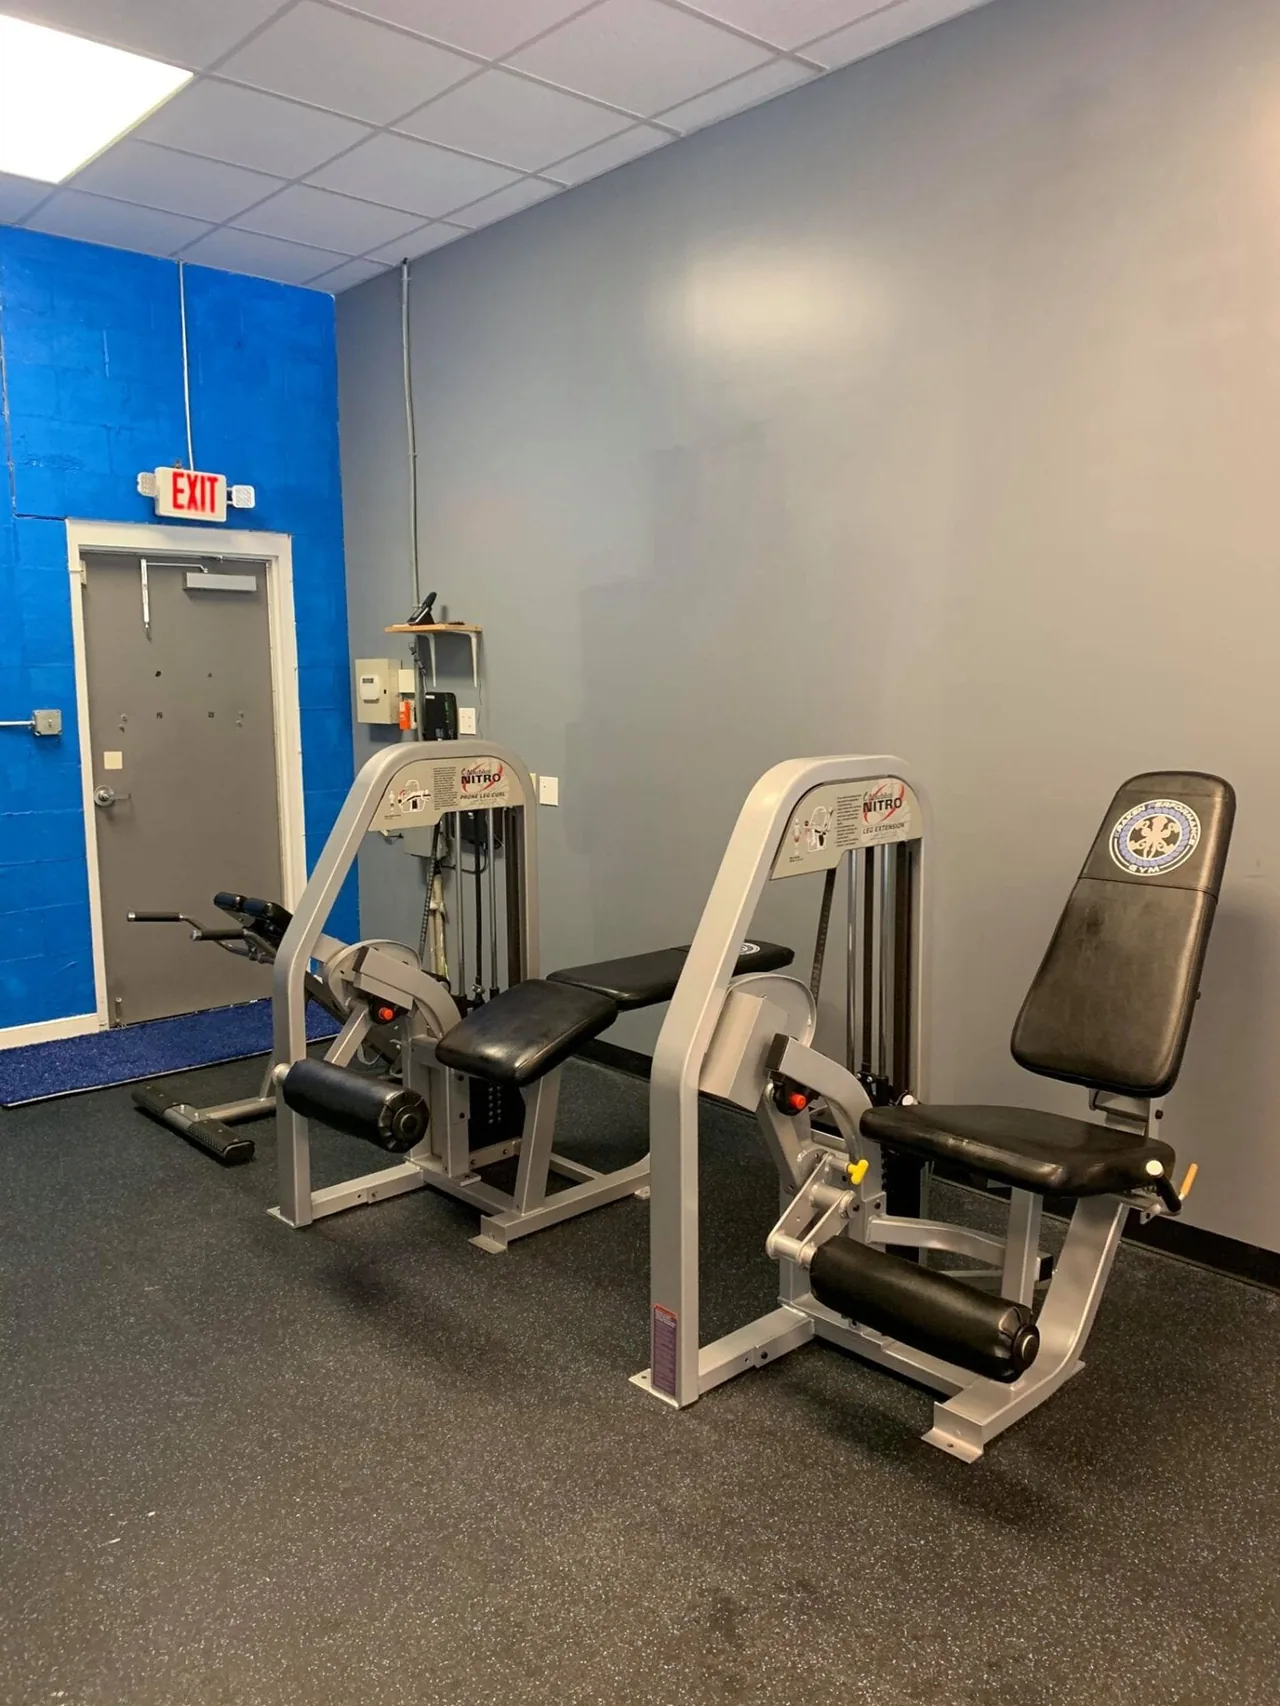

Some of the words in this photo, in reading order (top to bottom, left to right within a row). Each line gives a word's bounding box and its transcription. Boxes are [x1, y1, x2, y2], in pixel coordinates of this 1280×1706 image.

[172, 471, 218, 513] EXIT
[461, 773, 501, 784] NITRO
[863, 797, 902, 813] NITRO
[863, 826, 873, 834] LEG
[875, 822, 905, 833] EXTENSION
[1114, 805, 1146, 838] KRAKEN
[1128, 864, 1160, 874] GYM
